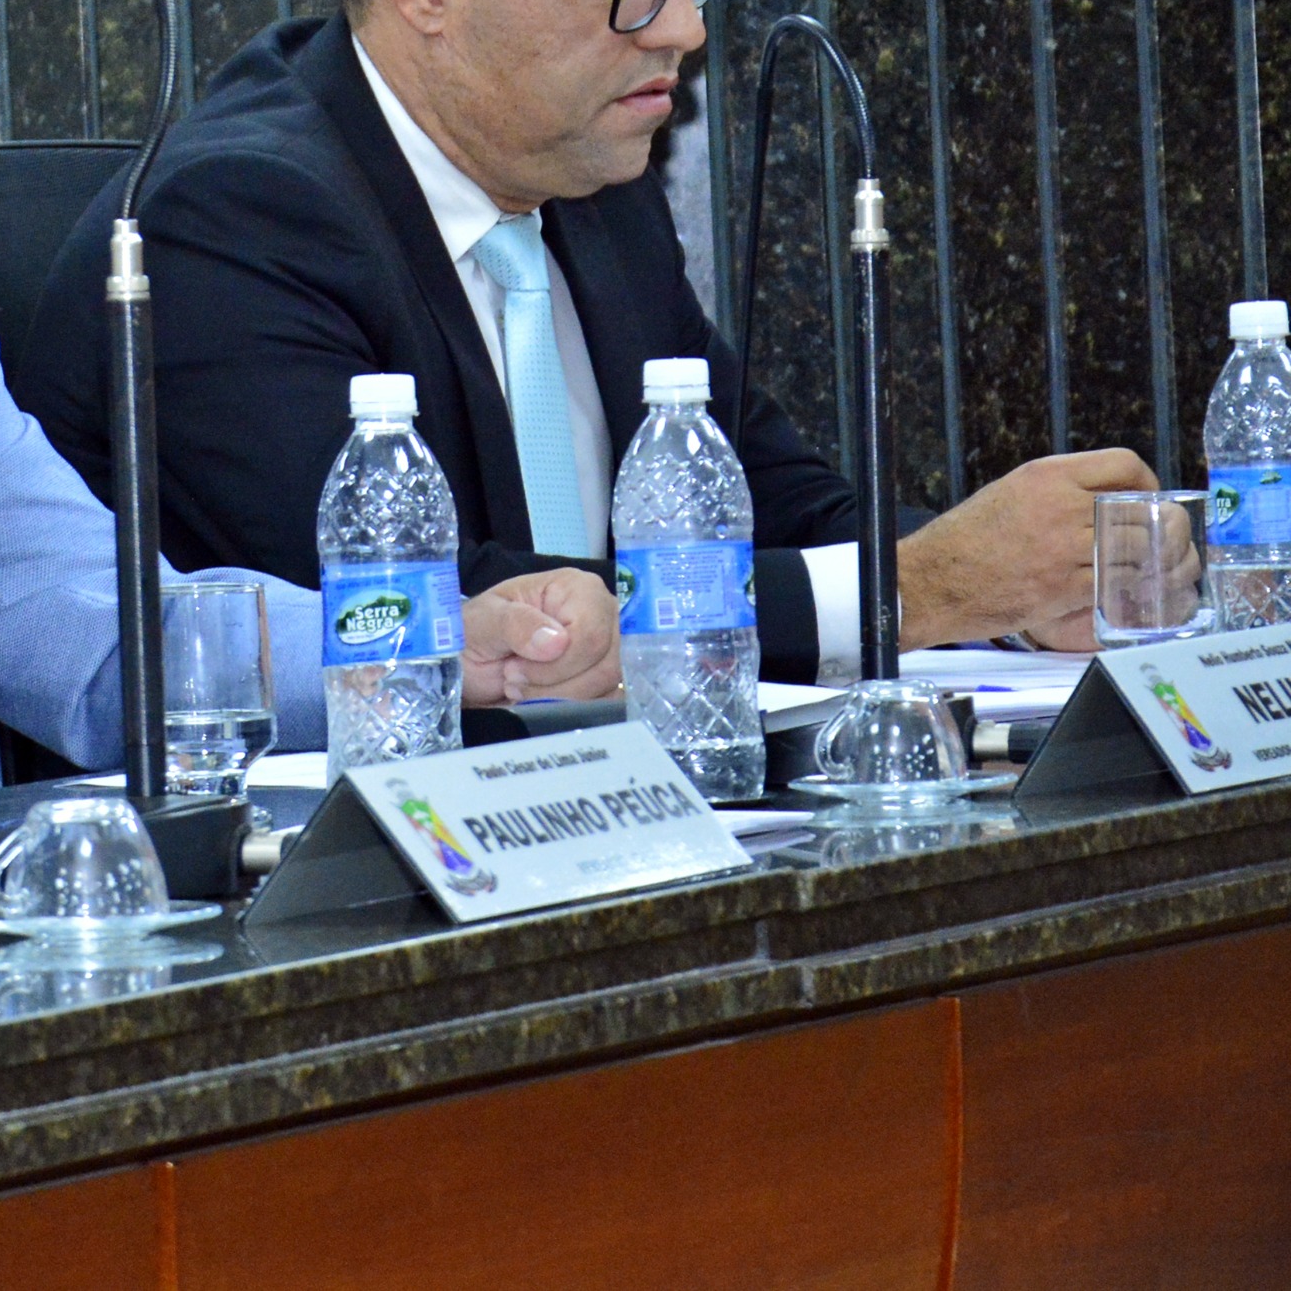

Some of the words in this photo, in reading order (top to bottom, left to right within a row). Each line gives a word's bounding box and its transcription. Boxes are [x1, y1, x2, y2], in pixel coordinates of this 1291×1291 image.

[355, 605, 400, 620] Serra
[346, 617, 394, 634] Negra
[473, 765, 508, 781] Paulo
[504, 758, 537, 775] César
[535, 755, 554, 770] de
[548, 753, 579, 768] Lima
[462, 797, 609, 853] PAULINHO
[599, 776, 702, 828] PEÚCA
